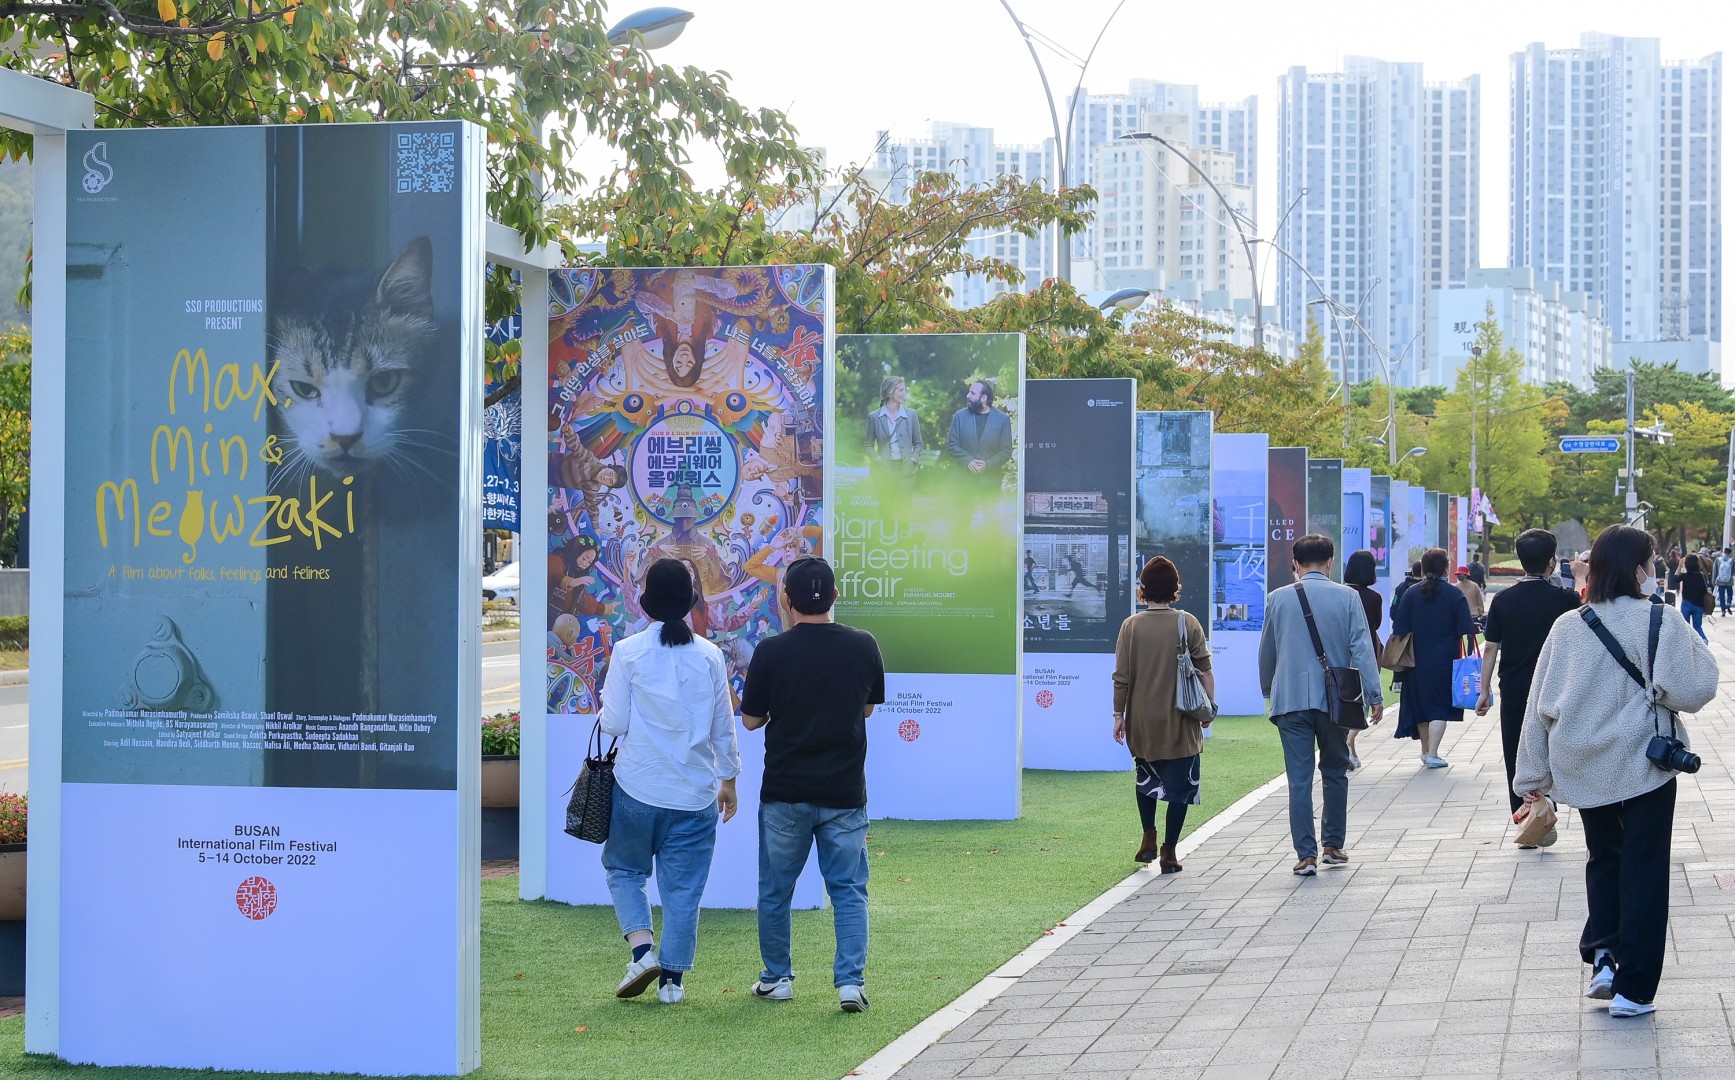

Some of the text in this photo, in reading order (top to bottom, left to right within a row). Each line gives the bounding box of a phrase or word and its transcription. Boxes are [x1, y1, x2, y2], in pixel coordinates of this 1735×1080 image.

[185, 299, 263, 313] SSO PRODUCTIONS
[205, 317, 243, 330] PRESENT
[725, 324, 750, 345] 나는
[751, 337, 777, 361] 너를
[551, 323, 649, 418] 그 어떤 인생을 살아도
[169, 347, 291, 421] Max,
[647, 436, 721, 454] 에브리씽
[151, 422, 282, 486] Min &
[647, 455, 721, 470] 에브리웨어
[647, 470, 721, 488] 올앳원스
[1271, 529, 1295, 541] CE
[841, 541, 968, 577] Fleeting
[108, 564, 330, 584] A film about folks, feelings and felines
[836, 570, 903, 598] ffair
[1024, 613, 1072, 631] 소년들
[104, 709, 139, 718] Padmakumar
[140, 710, 187, 720] Narasimhamurthy
[214, 710, 240, 720] Samiksha
[260, 711, 276, 720] Shael
[276, 711, 293, 720] Oswal
[352, 712, 388, 722] Padmakumar
[388, 713, 437, 724] Narasimhamurthy
[126, 719, 145, 728] Mithila
[174, 720, 218, 730] Narayanaswamy
[265, 721, 282, 730] Nikhil
[398, 723, 413, 732] Nitin
[413, 723, 431, 734] Dubey
[176, 730, 202, 740] Satyajeet
[203, 730, 221, 739] Kelkar
[249, 730, 267, 740] Ankita
[305, 731, 331, 742] Sudeepta
[119, 738, 131, 747] Adil
[131, 738, 155, 748] Hussain,
[156, 739, 178, 748] Mandira
[178, 739, 193, 749] Bedi,
[193, 739, 221, 749] Siddharth
[242, 740, 263, 750] Nasser,
[264, 740, 282, 750] Nafisa
[282, 740, 292, 751] Ali,
[293, 741, 312, 750] Medha
[312, 741, 337, 752] Shankar,
[360, 742, 378, 752] Bandi,
[379, 742, 402, 753] Gitanjali
[403, 742, 415, 752] Rao
[234, 825, 280, 837] BUSAN
[177, 837, 337, 852] International Film Festival
[198, 852, 316, 866] 5-14 October 2022
